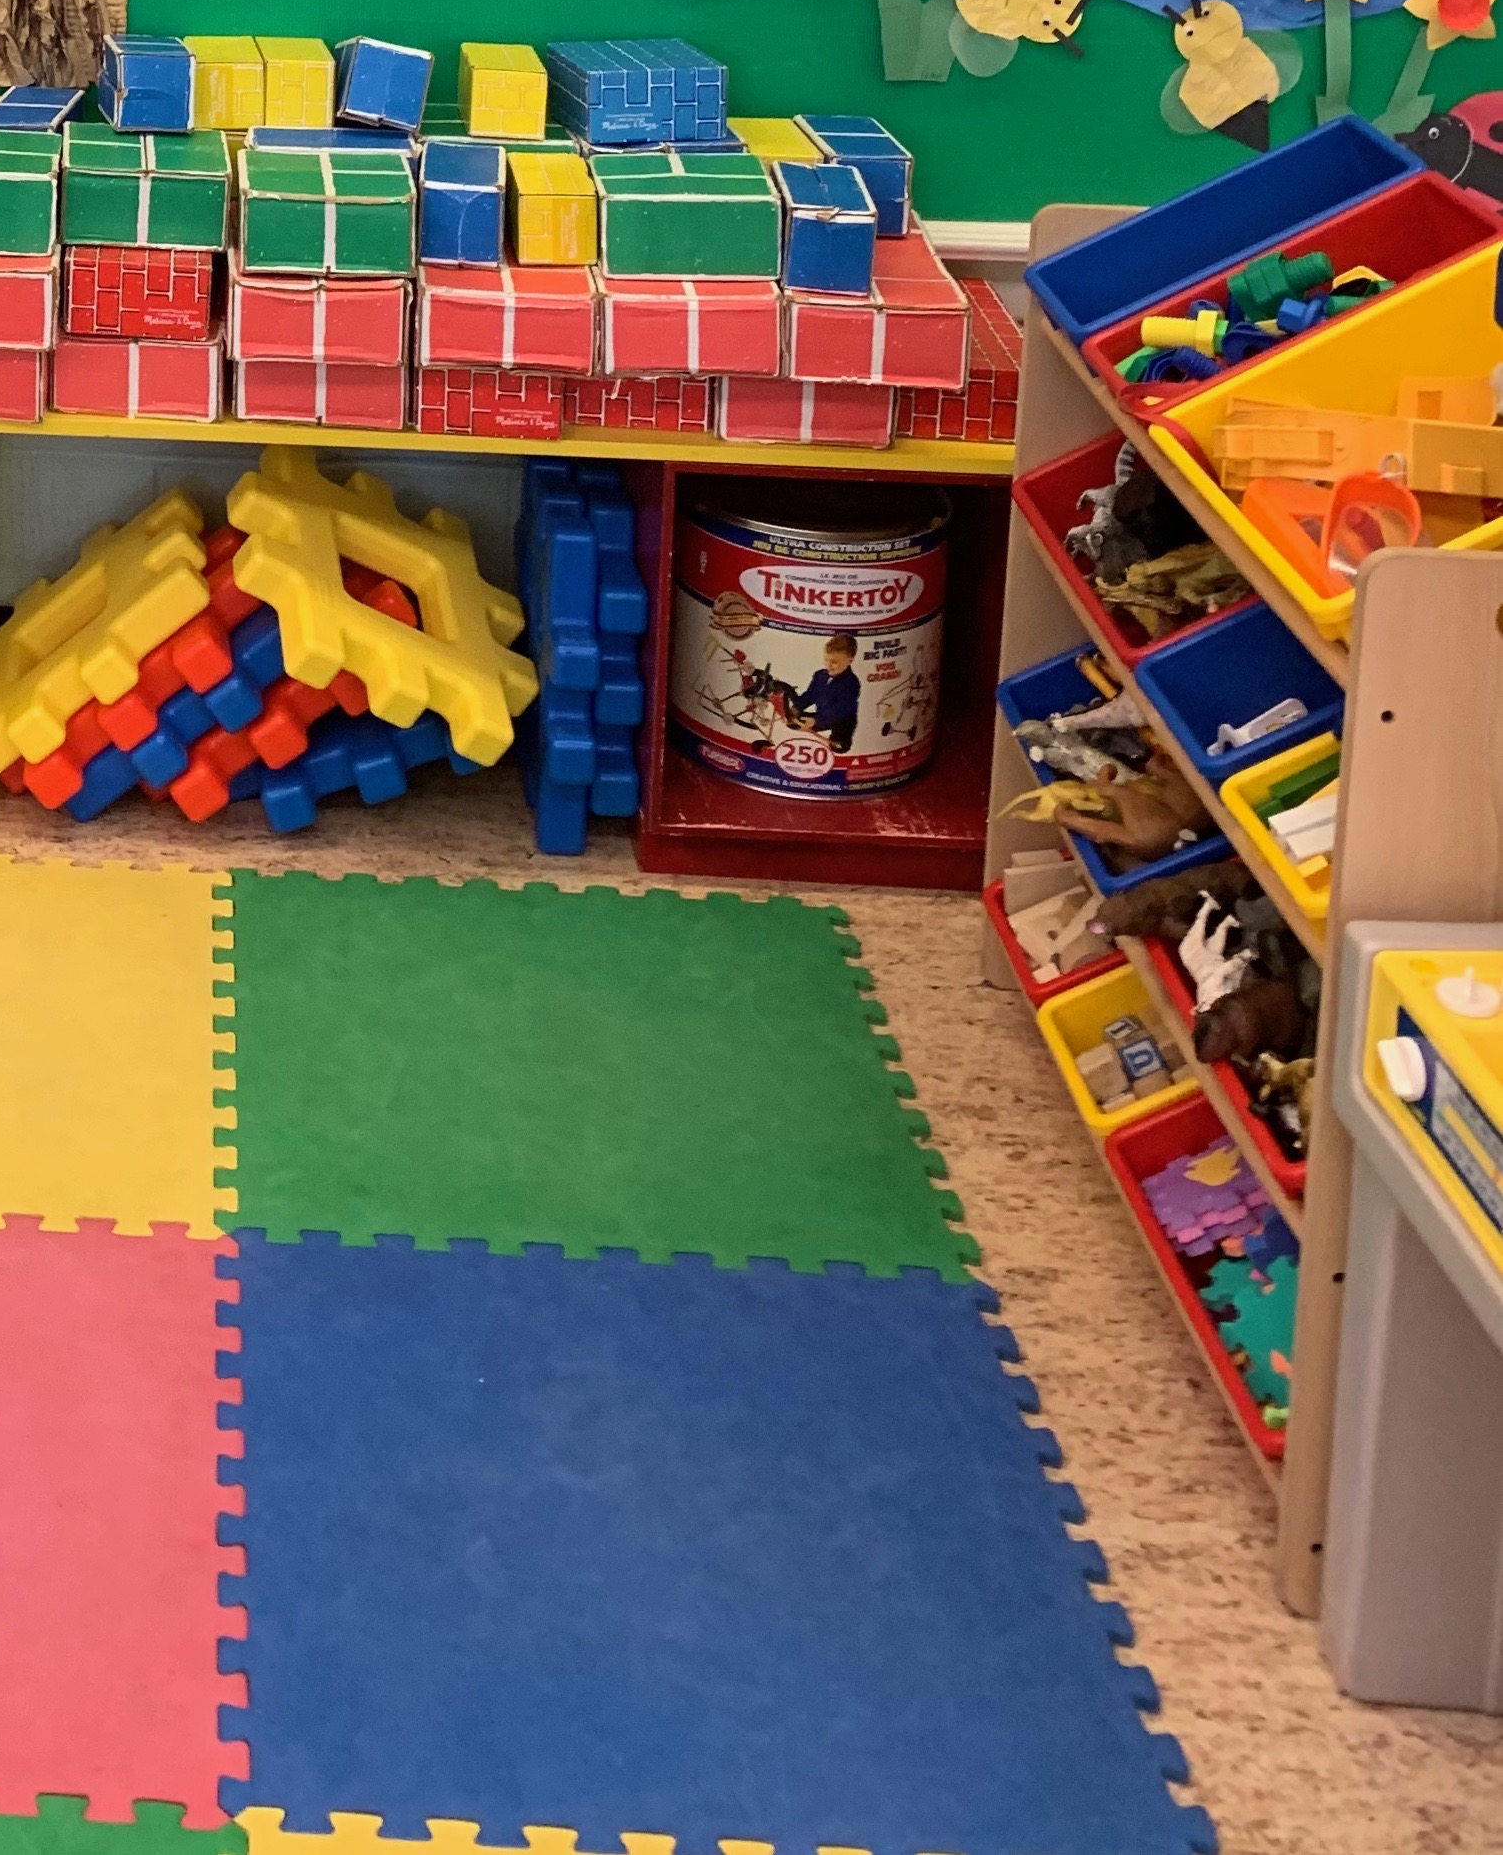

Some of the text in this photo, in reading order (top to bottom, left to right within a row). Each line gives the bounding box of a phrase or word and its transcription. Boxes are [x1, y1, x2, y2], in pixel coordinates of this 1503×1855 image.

[769, 535, 911, 553] ULTRA CONSTRUCTION SET
[781, 743, 828, 765] 250
